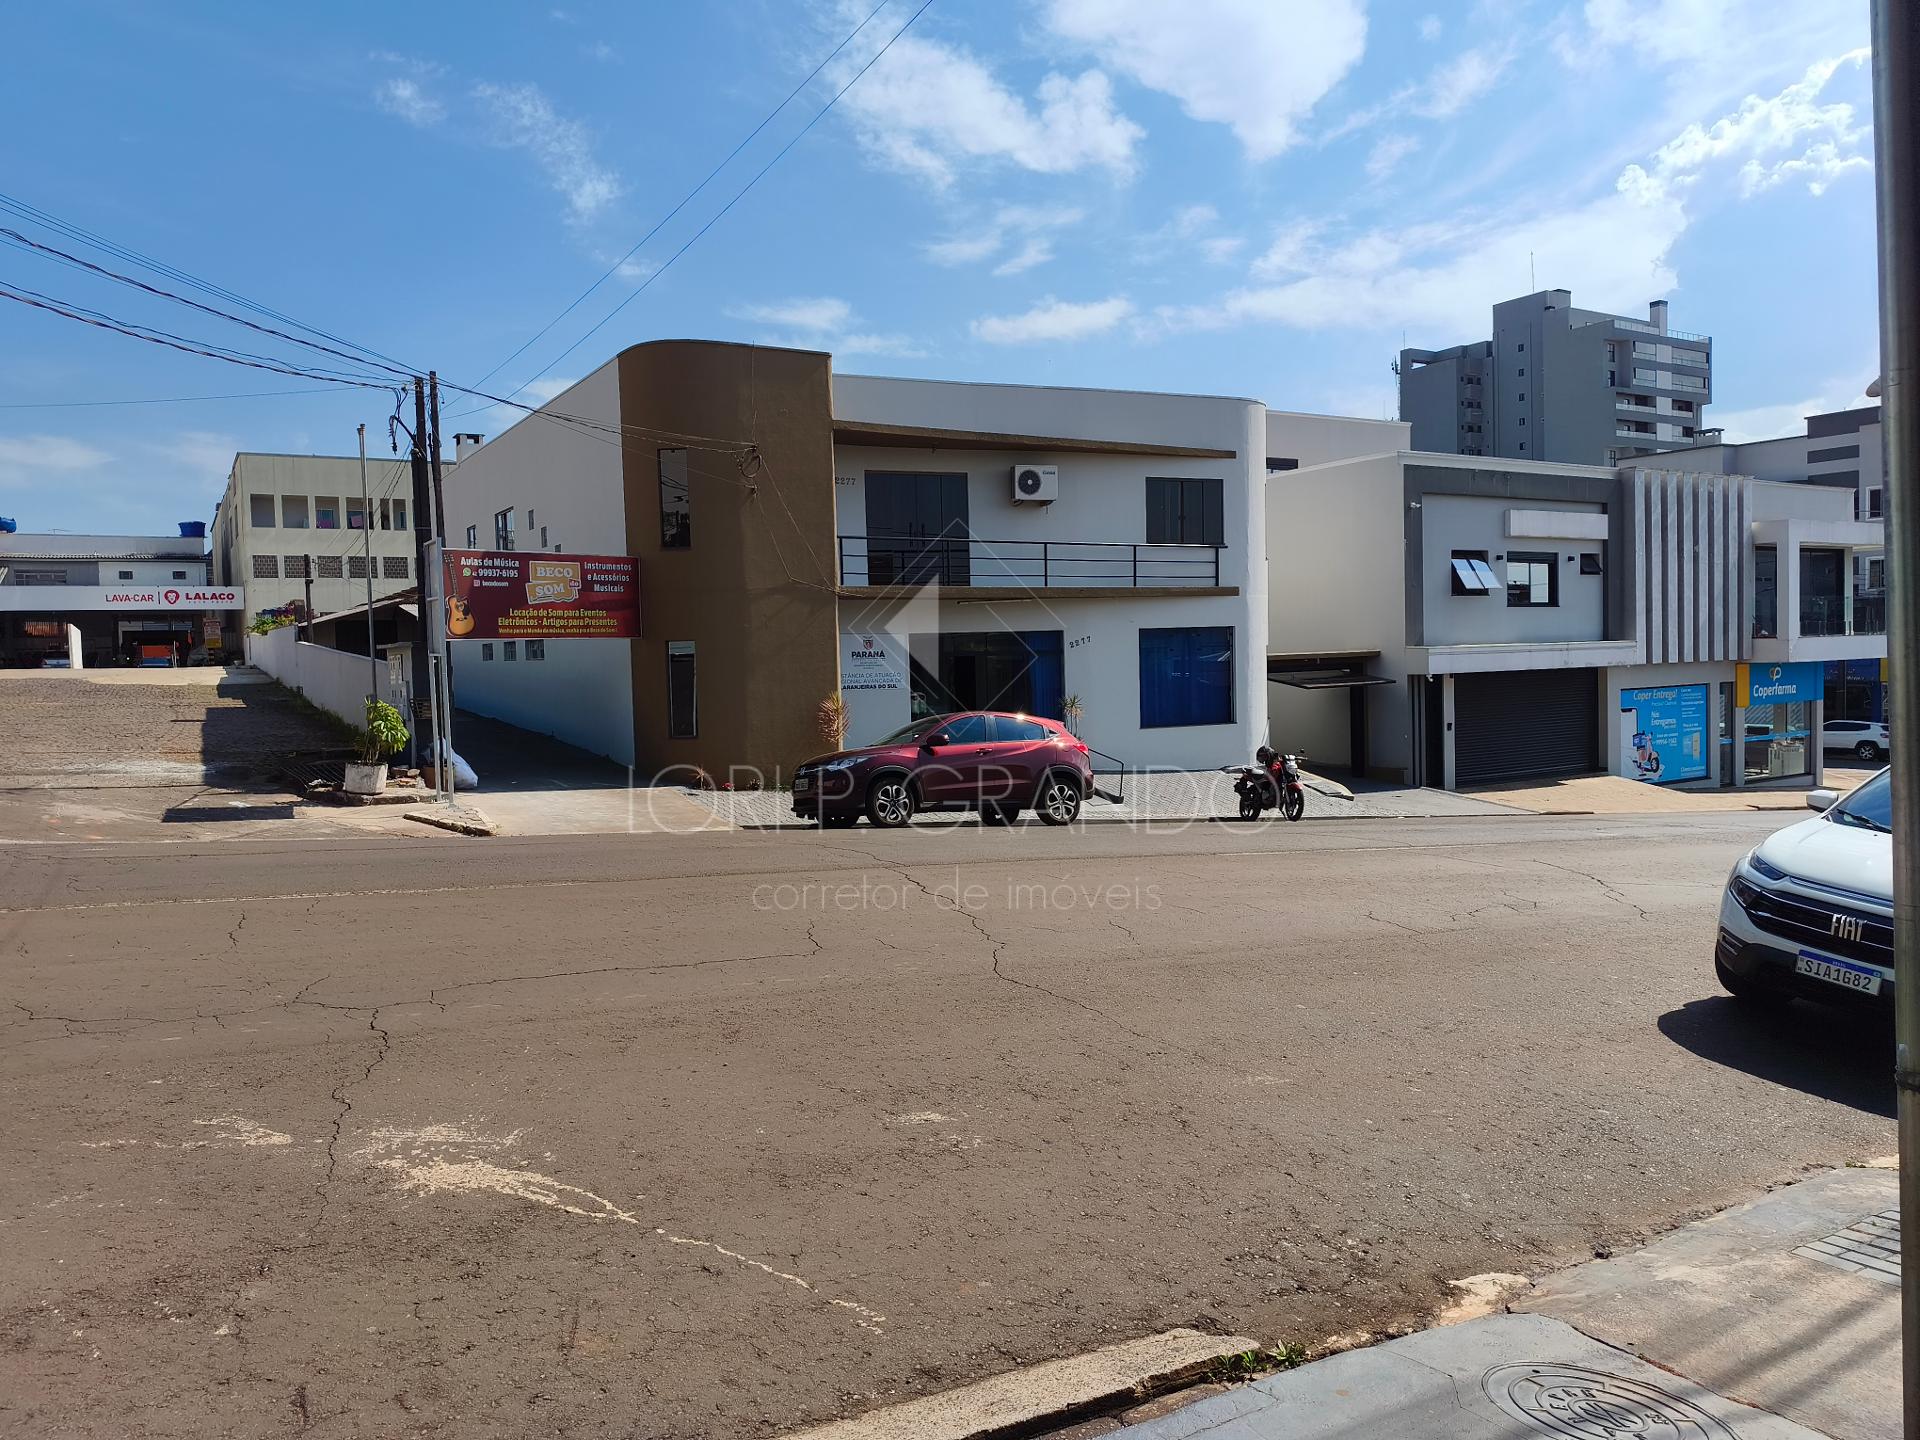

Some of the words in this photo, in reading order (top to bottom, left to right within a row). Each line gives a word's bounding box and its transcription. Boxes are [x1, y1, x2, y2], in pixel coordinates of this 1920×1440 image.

[834, 477, 856, 485] 2277
[461, 557, 482, 566] Aulas
[484, 558, 493, 567] de
[494, 558, 519, 567] Música
[584, 562, 632, 571] Instrumentos
[478, 568, 518, 578] 99937-6195
[536, 566, 573, 577] BECO
[592, 573, 630, 582] Acessórios
[535, 583, 565, 596] SOM
[593, 583, 624, 592] Musicais
[105, 594, 154, 603] LAVA-CAR
[185, 592, 235, 601] LALACO
[509, 608, 537, 618] Locação
[538, 608, 548, 616] de
[564, 610, 580, 618] para
[580, 609, 607, 617] Eventos
[498, 617, 538, 626] Eletrônicos
[543, 618, 568, 627] Artigos
[568, 619, 584, 627] para
[584, 618, 618, 626] Presentes
[1069, 635, 1091, 648] 2277
[851, 650, 885, 658] PARANÁ
[1633, 690, 1652, 702] Coper
[1653, 689, 1678, 701] Entrega!
[1753, 682, 1797, 699] Coperfarma
[1830, 913, 1868, 942] FIAT
[1804, 960, 1872, 990] SIA1G82
